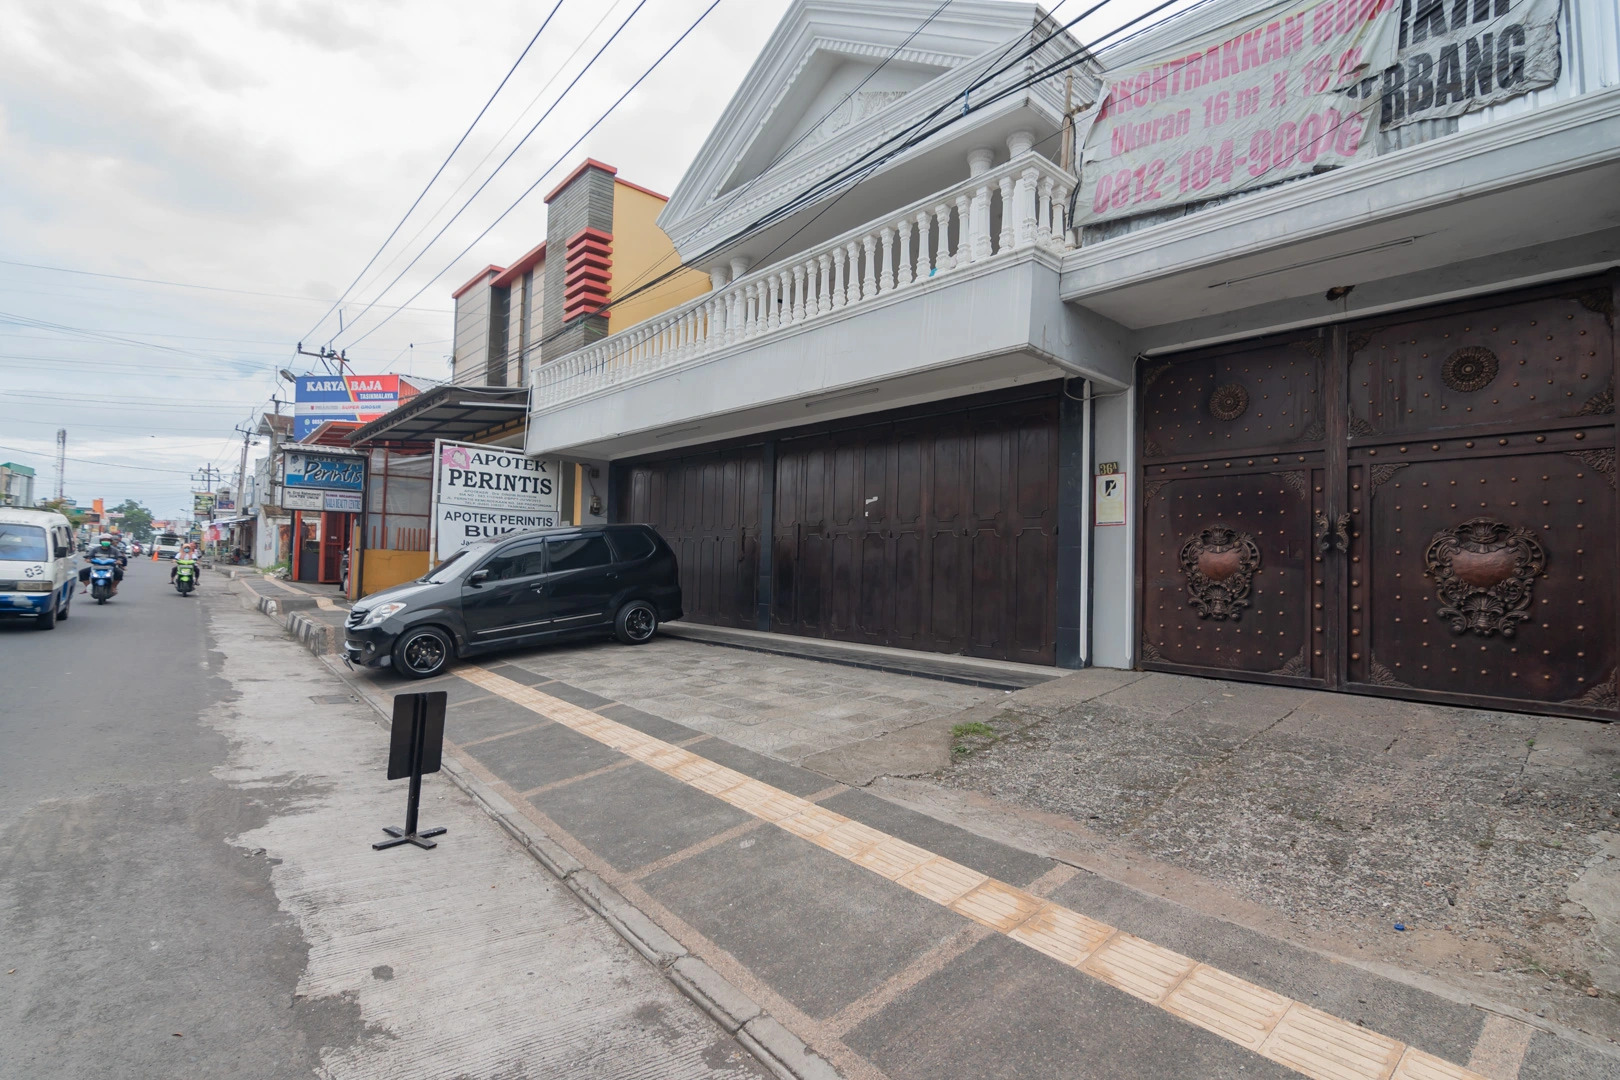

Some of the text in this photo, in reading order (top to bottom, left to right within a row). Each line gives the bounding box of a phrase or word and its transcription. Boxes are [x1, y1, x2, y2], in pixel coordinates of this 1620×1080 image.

[1348, 24, 1526, 129] RBANG
[1110, 107, 1191, 156] Ukuran
[1202, 90, 1229, 128] 16
[1233, 85, 1260, 119] m
[1270, 70, 1289, 108] X
[306, 380, 382, 392] KARYA BAJA
[360, 392, 394, 400] TASIKMALAYA
[470, 452, 547, 473] APOTEK
[303, 461, 362, 484] Perintis
[447, 468, 553, 496] PERINTIS
[444, 511, 553, 527] APOTEK PERINTIS
[465, 525, 529, 538] BUK
[24, 564, 44, 579] 03
